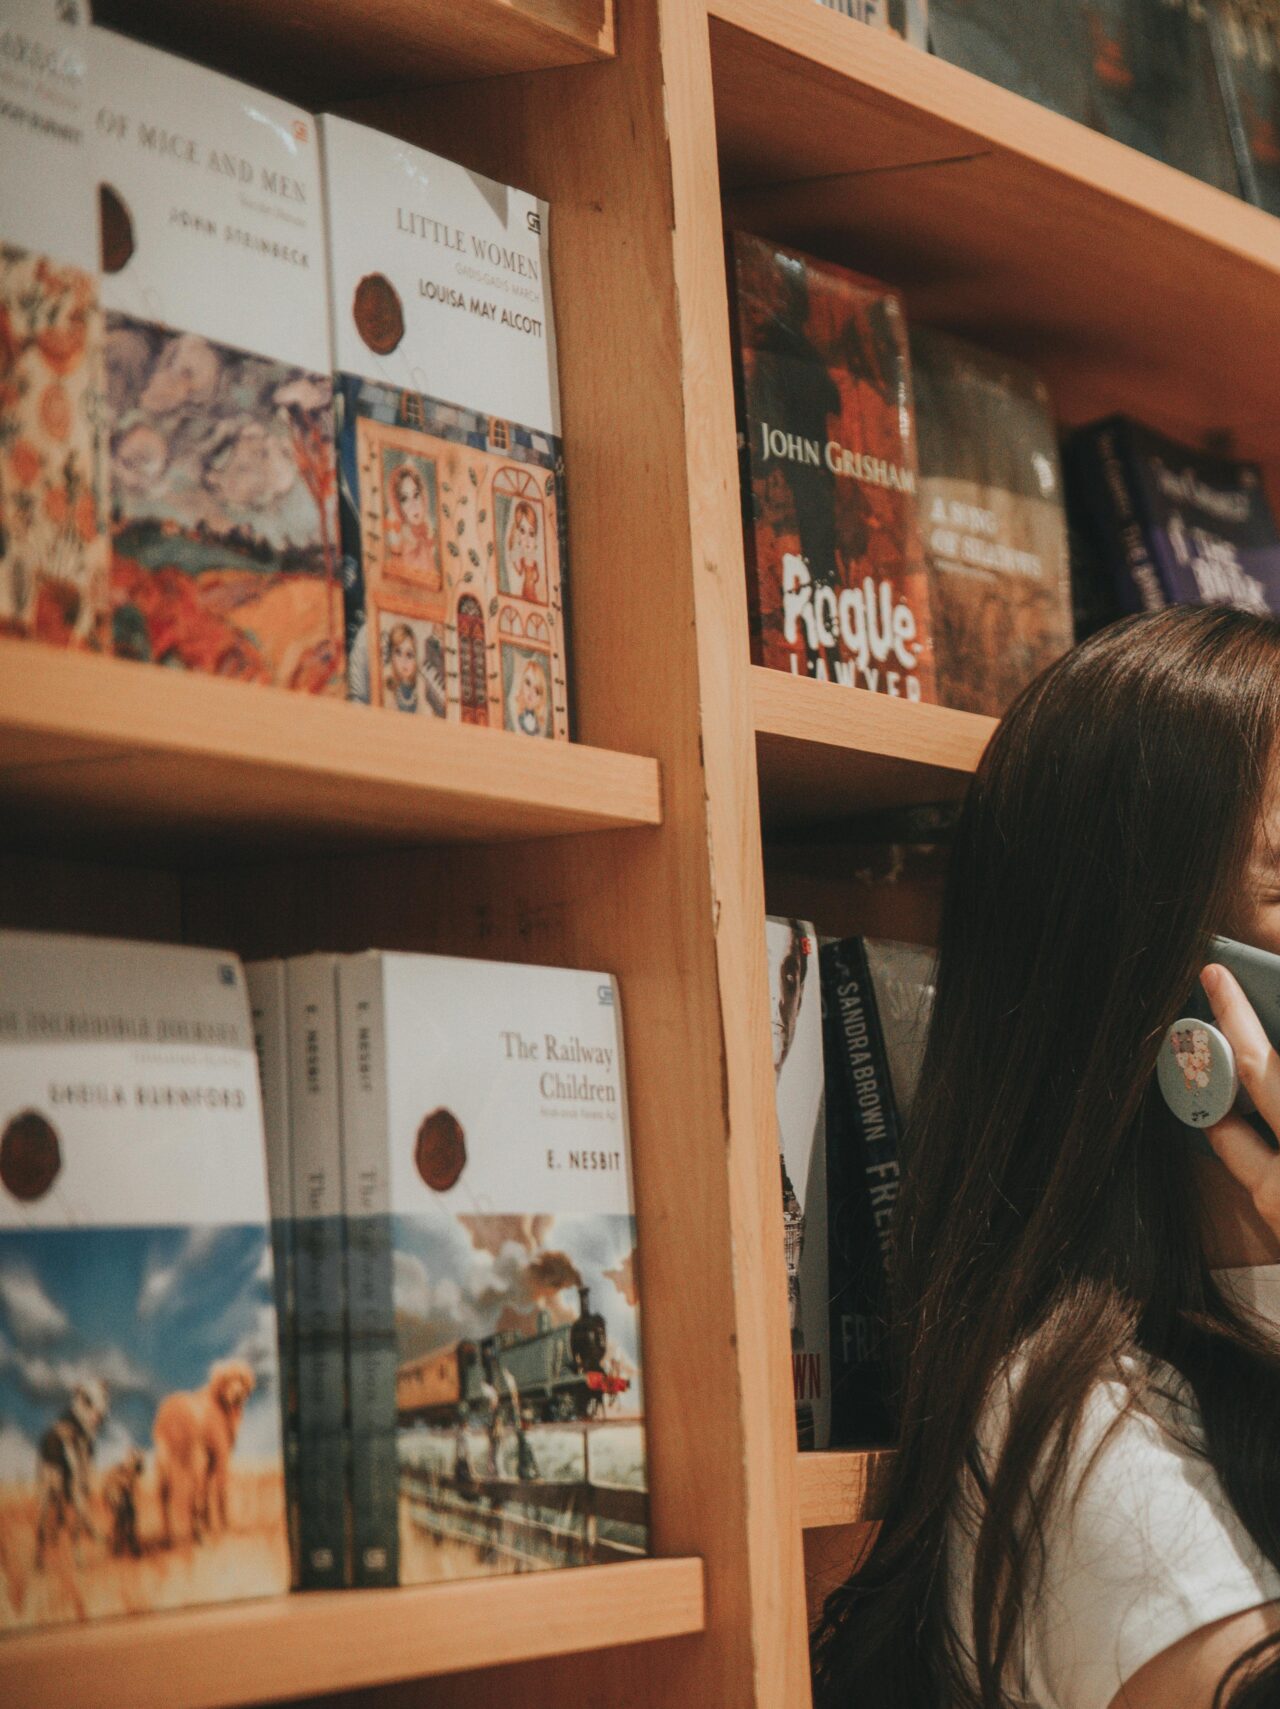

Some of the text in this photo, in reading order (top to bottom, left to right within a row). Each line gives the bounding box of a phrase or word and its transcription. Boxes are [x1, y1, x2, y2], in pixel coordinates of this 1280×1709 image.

[138, 122, 199, 163] MICE
[208, 149, 253, 183] AND
[261, 167, 307, 203] MEN
[397, 207, 538, 280] LITTLE WOMEN
[419, 278, 542, 338] LOUISA MAY ALCOTT
[761, 422, 916, 493] JOHN GRISHAM
[782, 553, 918, 671] Rogue
[500, 1031, 613, 1073] The Railway
[539, 1071, 616, 1102] Children
[837, 982, 887, 1142] SANDRA BROWN
[547, 1148, 620, 1171] E. NESBIT
